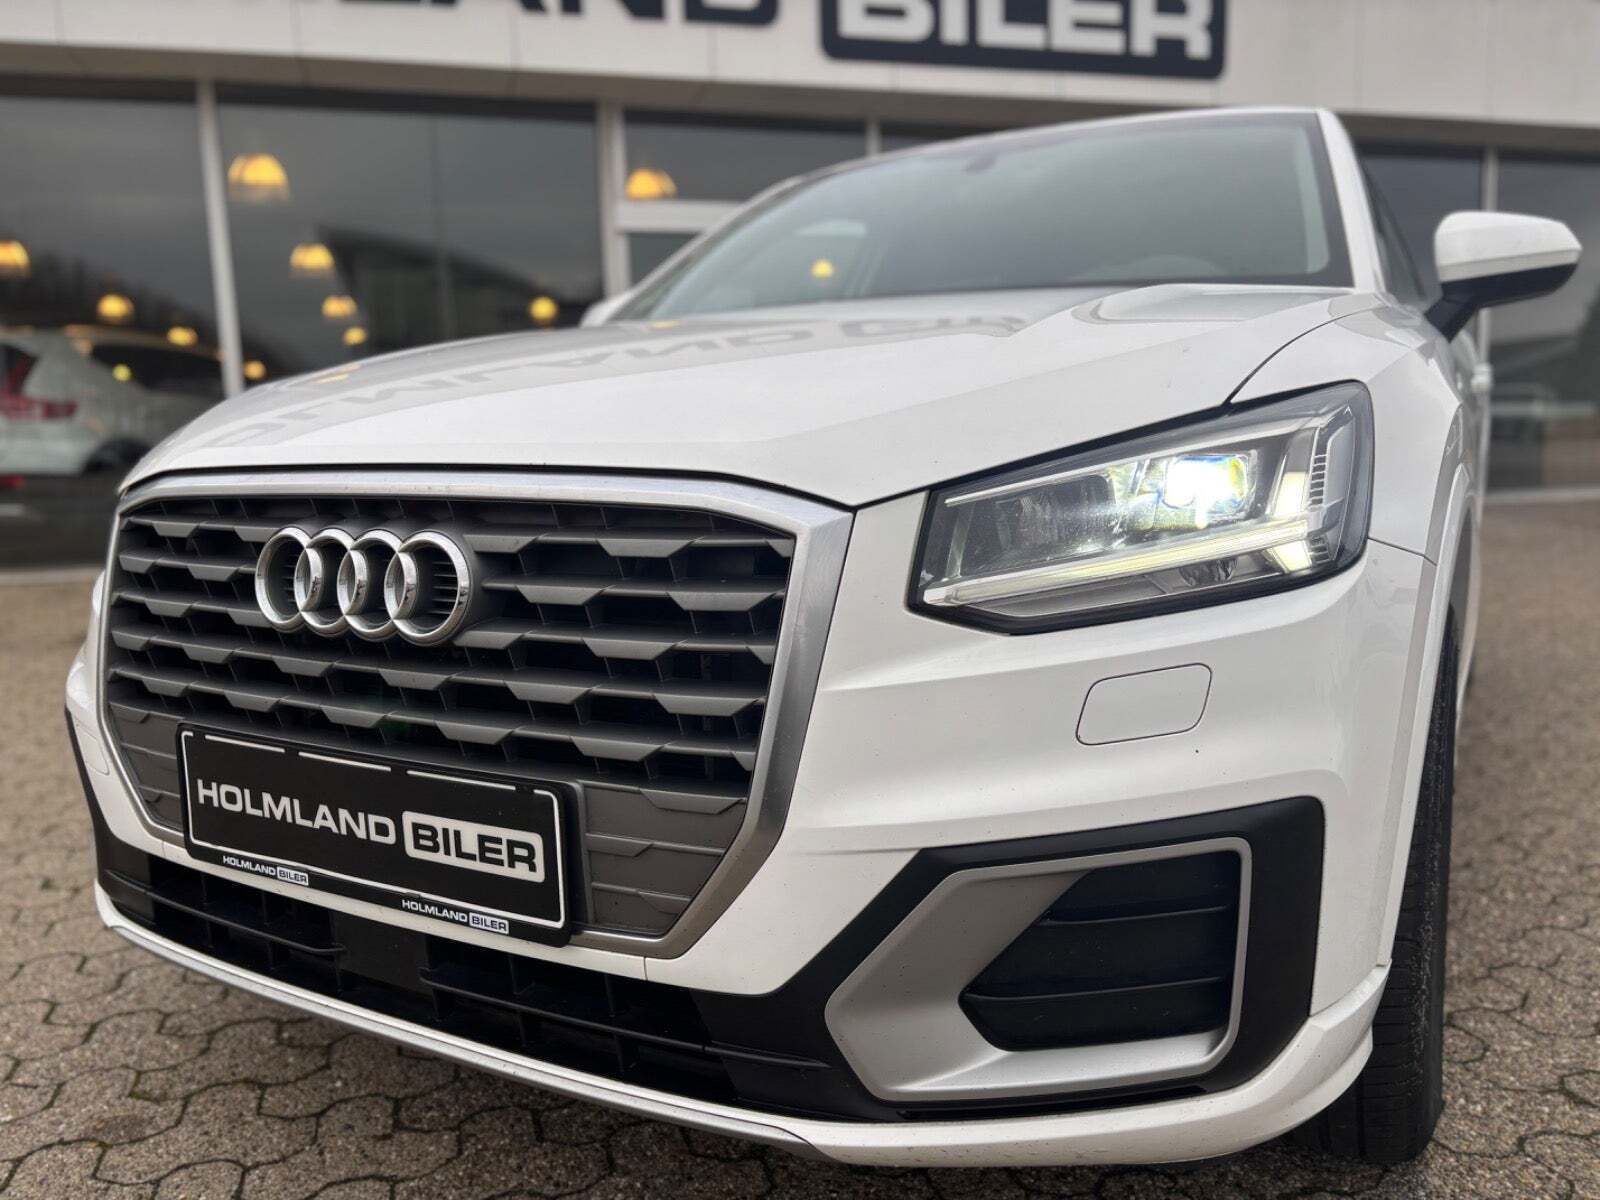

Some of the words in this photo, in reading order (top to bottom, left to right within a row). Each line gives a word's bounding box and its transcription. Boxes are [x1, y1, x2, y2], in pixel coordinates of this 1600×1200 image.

[197, 779, 397, 845] HOLMLAND
[411, 822, 537, 872] BILER
[223, 856, 276, 875] HOLMLAND
[279, 869, 307, 883] BILER
[402, 900, 467, 922] HOLMLAND
[471, 915, 507, 931] BILER
